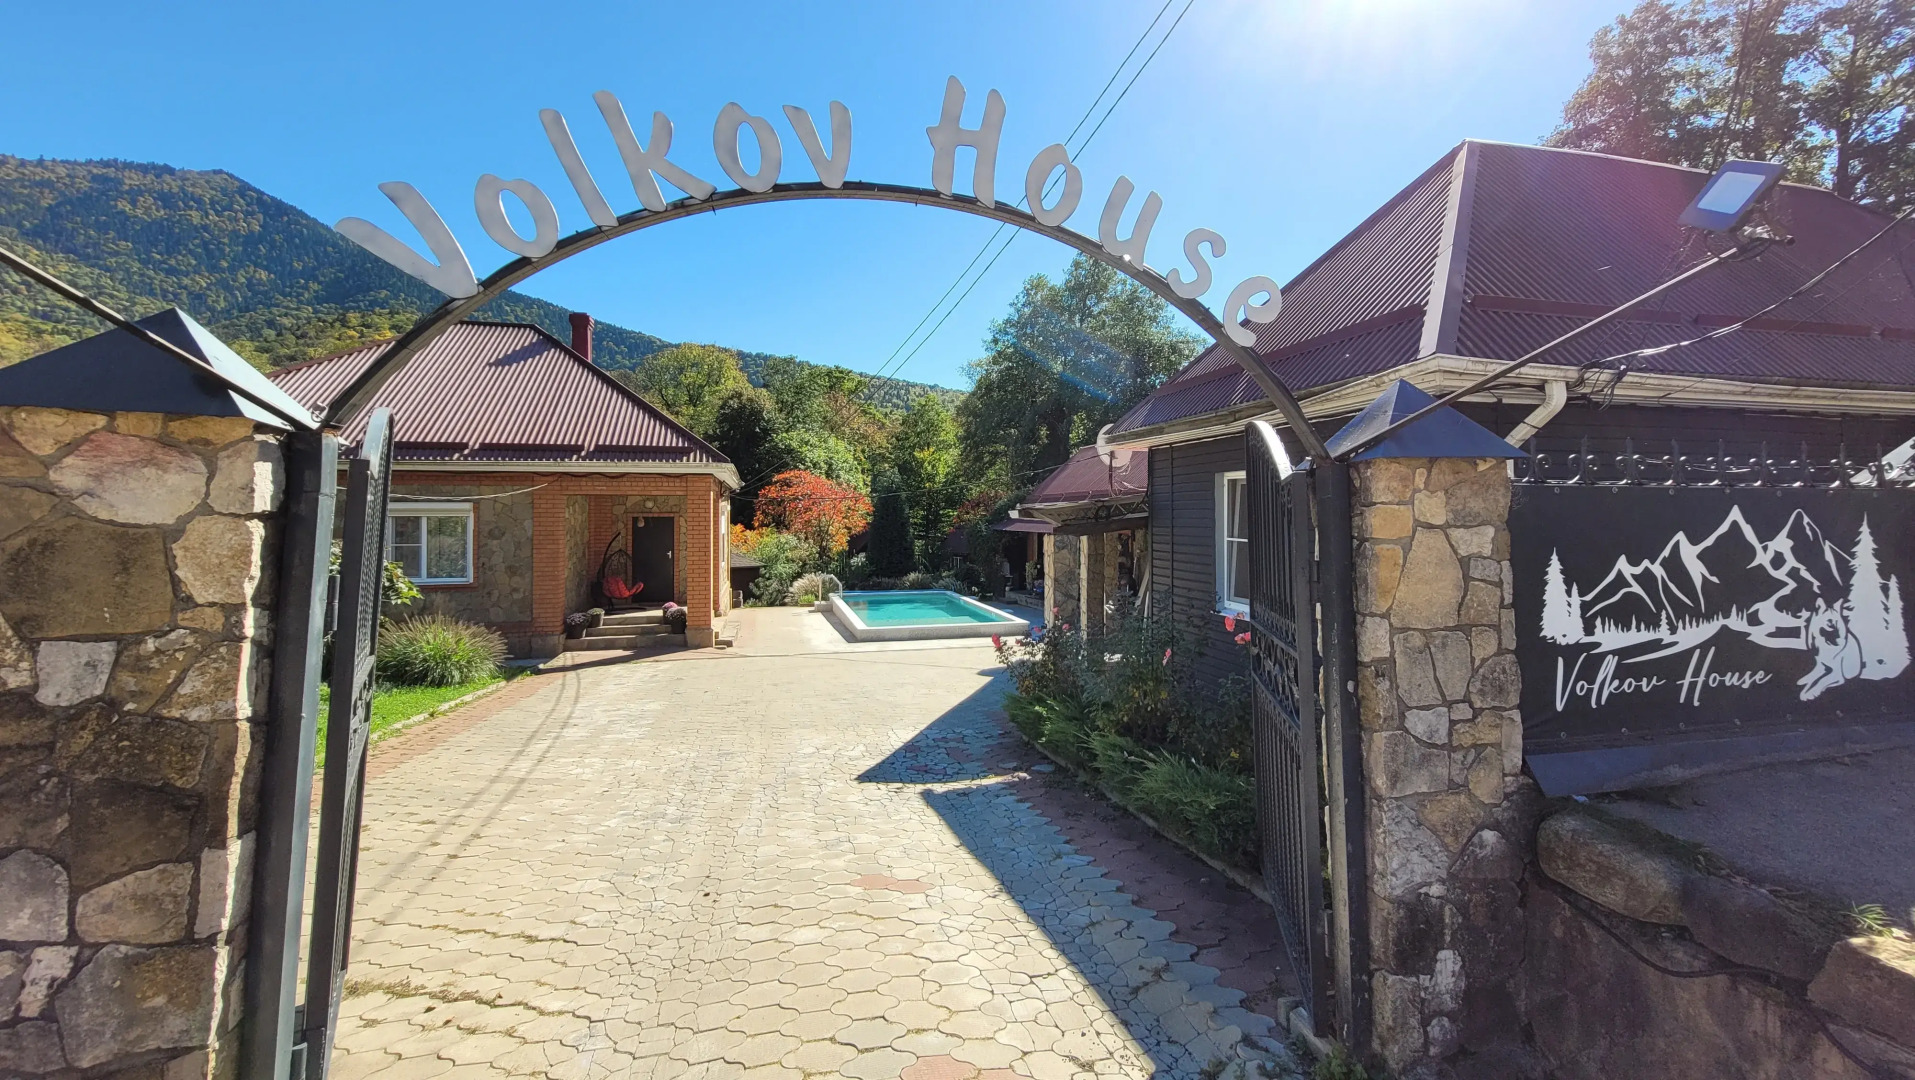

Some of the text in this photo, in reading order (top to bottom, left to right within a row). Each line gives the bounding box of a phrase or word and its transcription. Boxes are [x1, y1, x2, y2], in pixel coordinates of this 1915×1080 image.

[334, 75, 1282, 347] Volkov House
[1556, 646, 1773, 712] Volkov House
